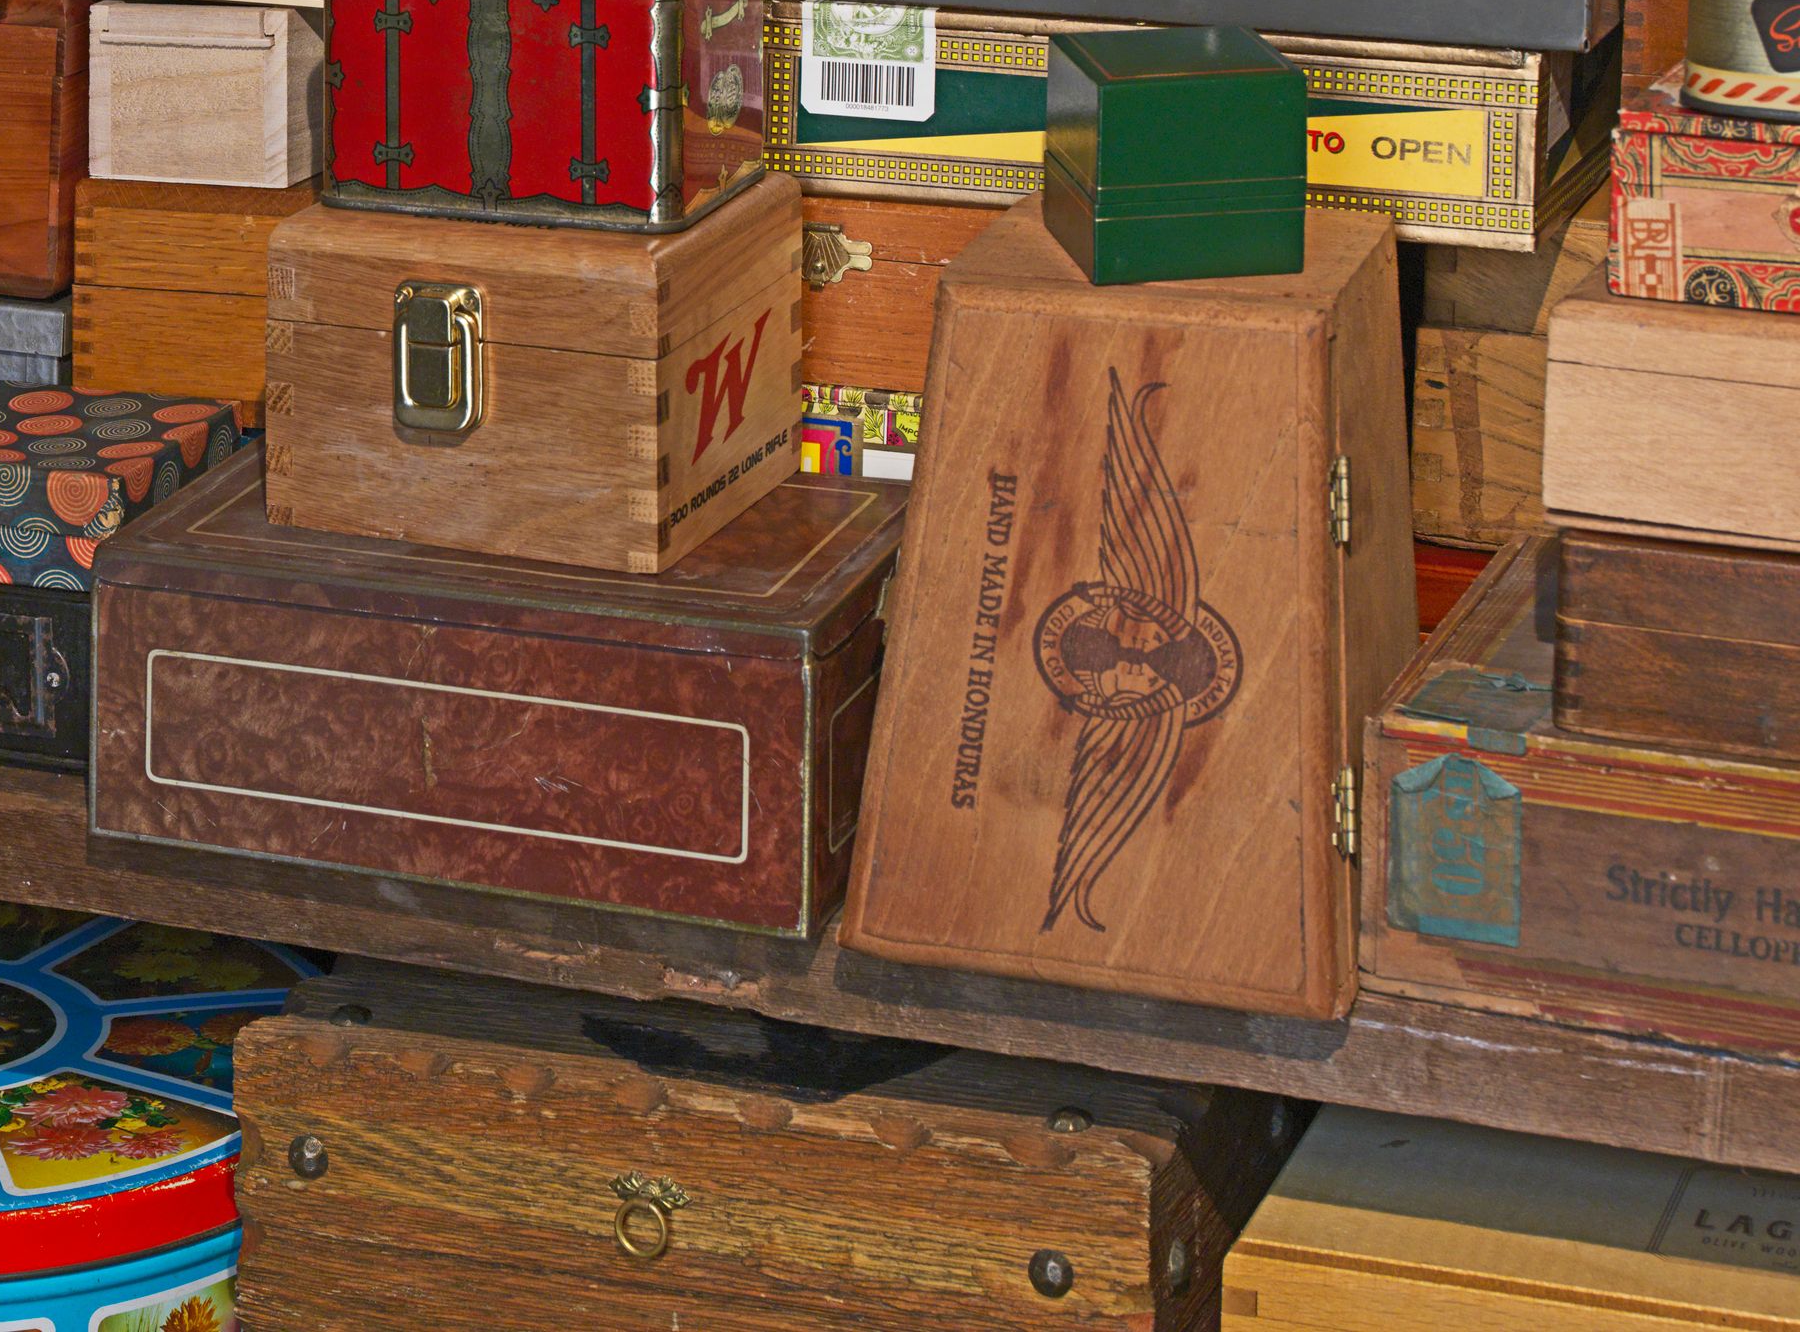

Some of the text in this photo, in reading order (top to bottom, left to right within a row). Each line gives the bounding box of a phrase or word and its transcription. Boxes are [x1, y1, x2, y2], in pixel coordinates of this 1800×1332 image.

[1307, 130, 1473, 167] TO OPEN
[684, 307, 773, 467] W
[669, 428, 789, 529] 300 ROUNDS 22 LONG RIFLE
[950, 472, 1018, 810] HAND MADE IN HONDURAS
[1042, 603, 1075, 651] CIGAR
[1199, 616, 1235, 670] INDIAN
[1430, 827, 1486, 897] 50
[1605, 863, 1735, 924] Strictly
